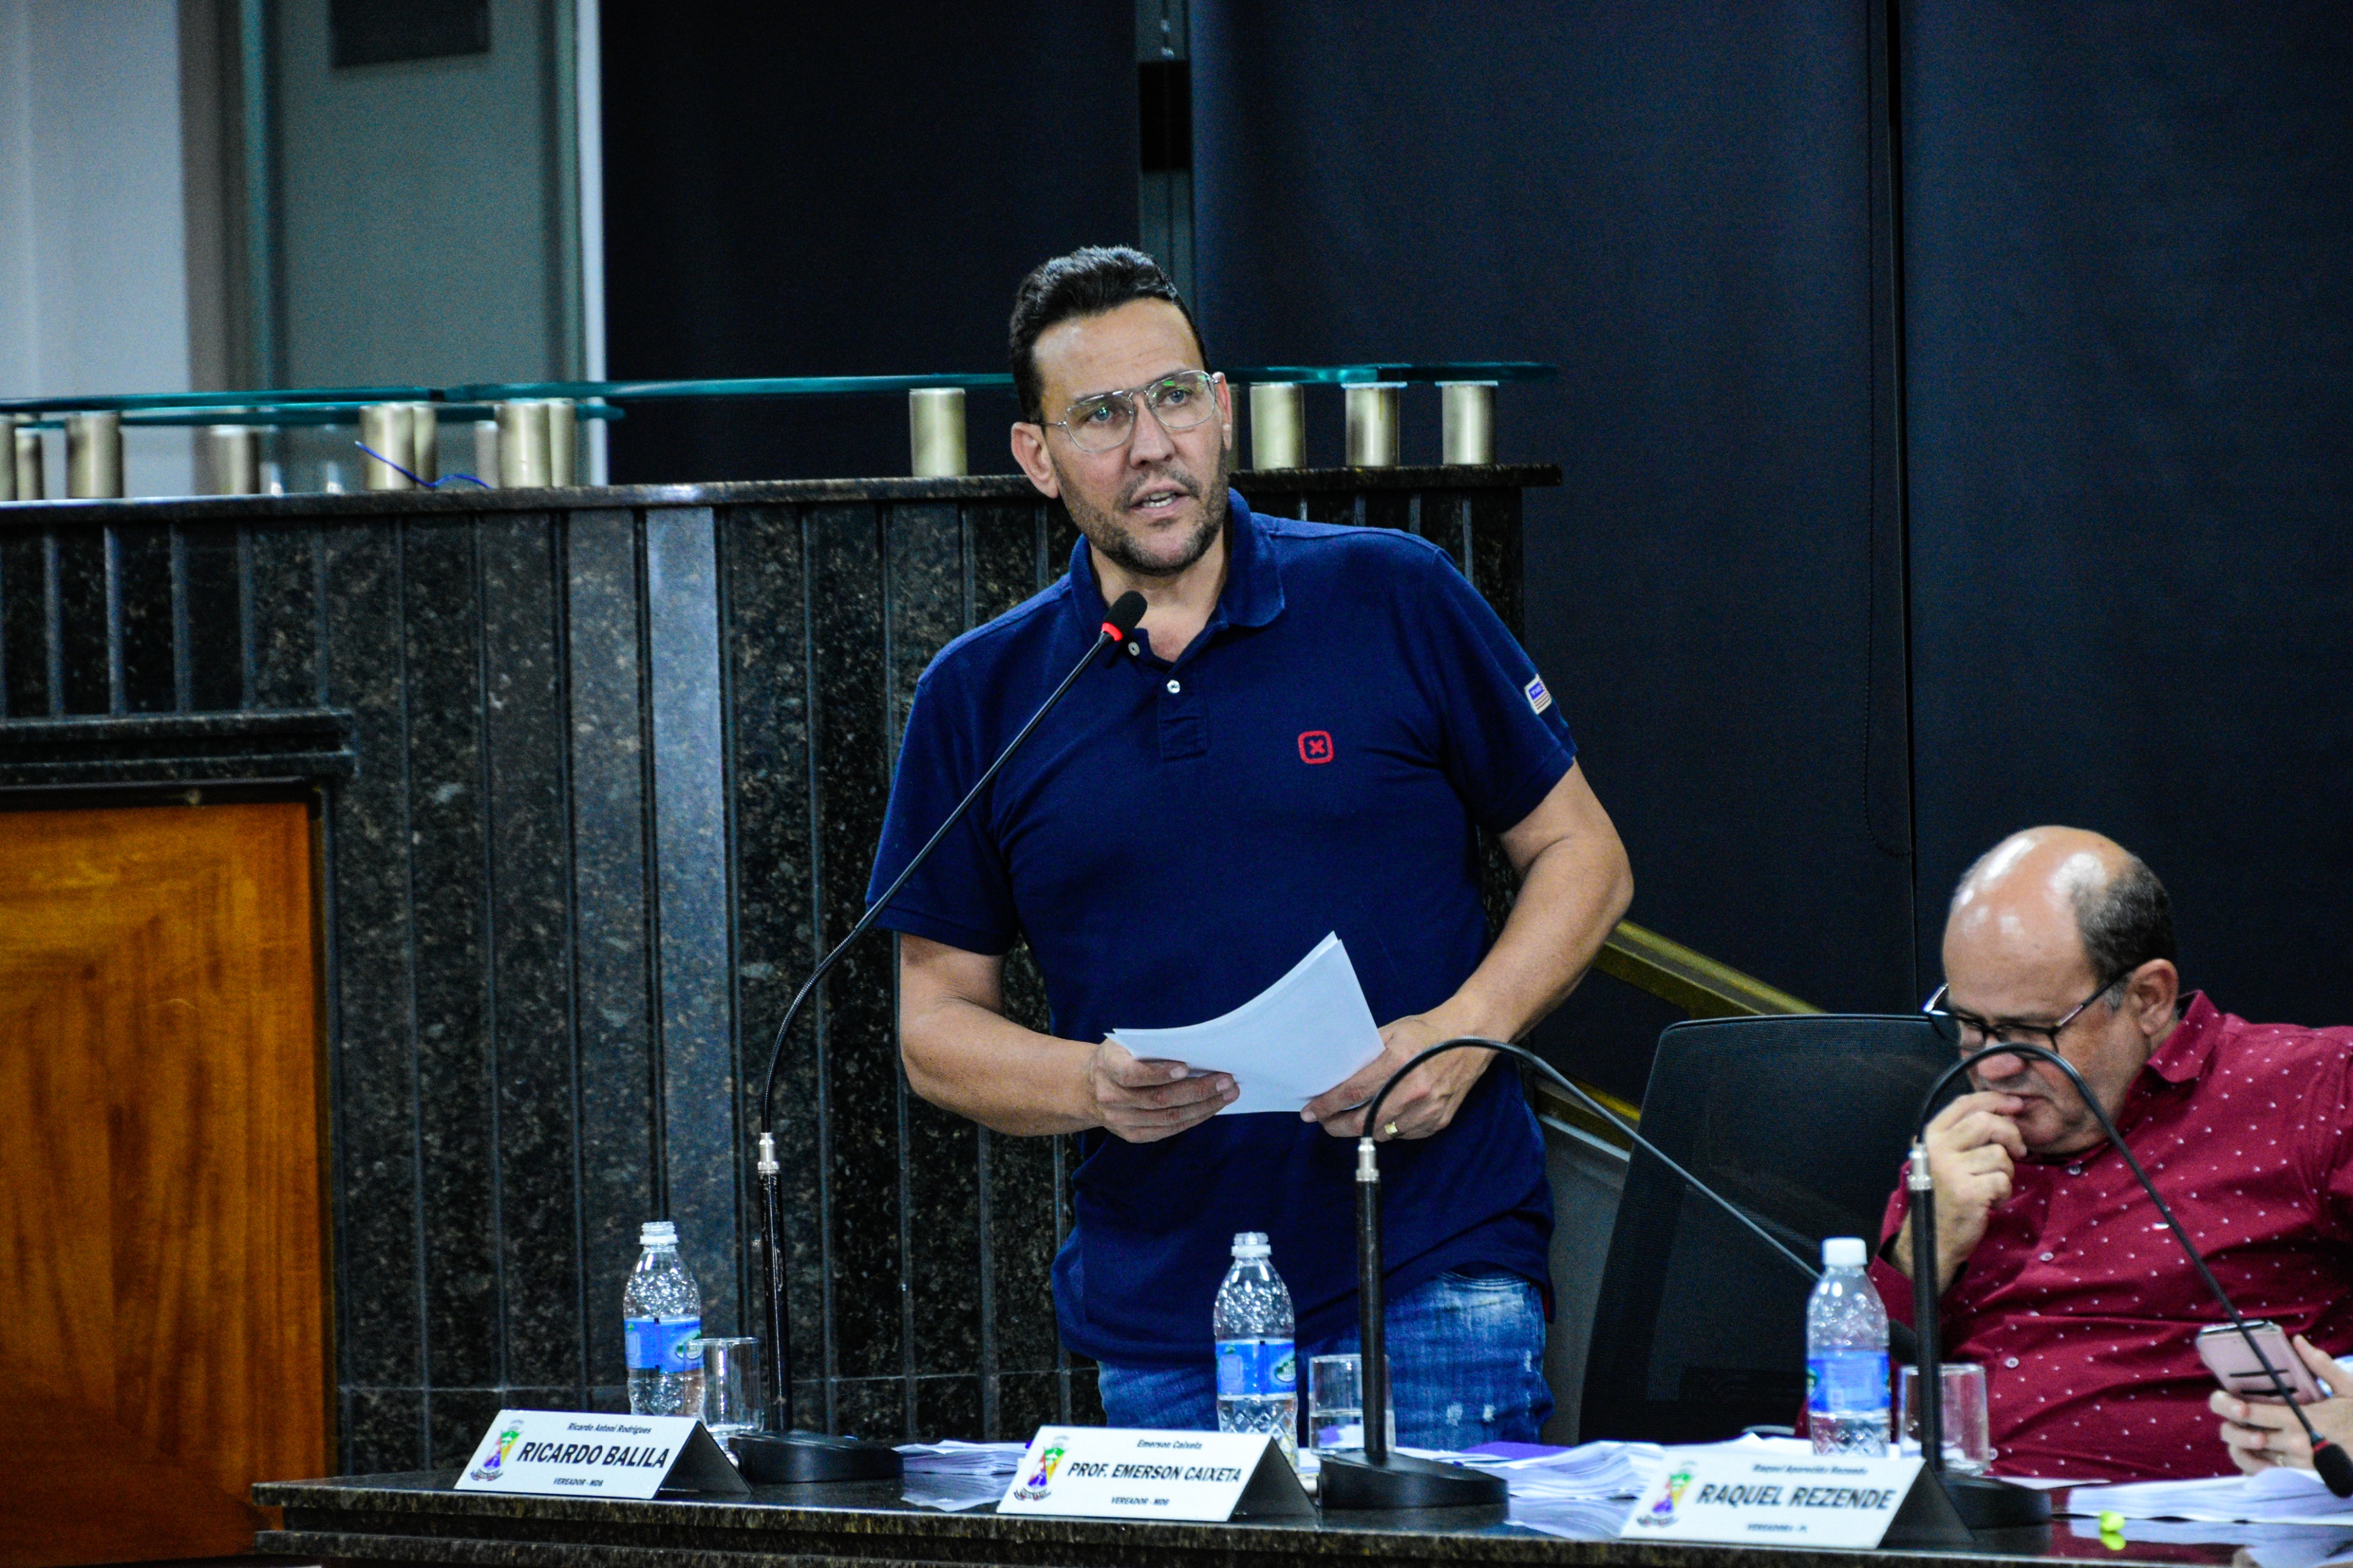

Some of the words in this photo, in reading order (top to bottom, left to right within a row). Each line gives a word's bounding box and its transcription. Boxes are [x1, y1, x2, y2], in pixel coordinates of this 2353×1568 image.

[566, 1422, 594, 1431] Ricardo
[616, 1425, 652, 1435] Rodrigues
[1137, 1439, 1171, 1448] Emerson
[1172, 1440, 1203, 1450] Caixeta
[516, 1442, 603, 1465] RICARDO
[602, 1445, 670, 1468] BALILA
[1067, 1462, 1108, 1477] PROF.
[1111, 1464, 1184, 1481] EMERSON
[1184, 1467, 1242, 1483] CAIXETA
[554, 1477, 586, 1486] VEREADOR
[1111, 1497, 1149, 1505] VEREADOR
[1695, 1484, 1784, 1509] RAQUEL
[1787, 1487, 1897, 1510] REZENDE
